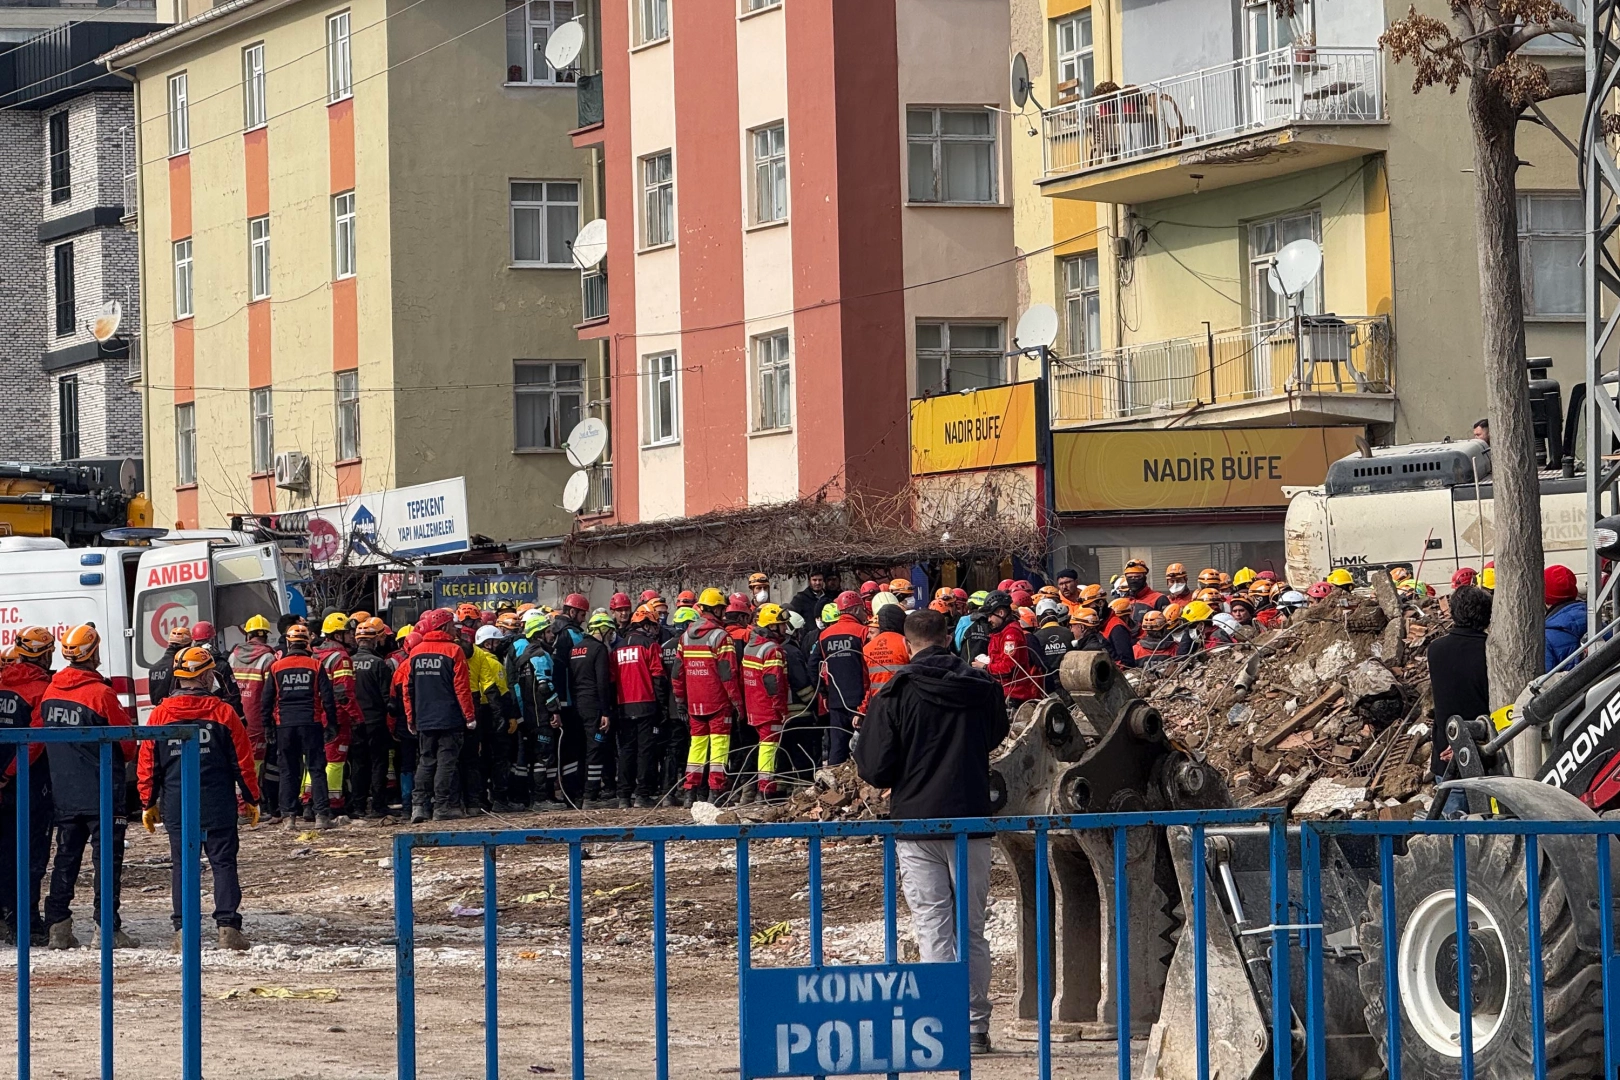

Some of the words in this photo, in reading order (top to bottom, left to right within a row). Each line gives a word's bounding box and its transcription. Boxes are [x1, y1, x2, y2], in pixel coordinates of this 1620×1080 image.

[944, 414, 973, 445] NADİR
[975, 411, 1001, 441] BÜFE
[1143, 452, 1215, 482] NADİR
[1221, 450, 1283, 481] BÜFE
[406, 495, 445, 520] TEPEKENT
[397, 528, 412, 542] YAPI
[413, 515, 455, 540] MALZEMELERİ
[1333, 555, 1369, 565] HMK
[147, 561, 208, 587] AMBU
[442, 580, 534, 598] KEÇELİKOYAK
[0, 607, 23, 624] T.C.
[827, 639, 851, 651] AFAD
[1045, 642, 1066, 650] ANDA
[353, 660, 371, 670] FAD
[415, 658, 442, 669] AFAD
[282, 674, 310, 685] AFAD
[46, 707, 80, 725] AFAD
[798, 970, 920, 1004] KONYA
[776, 1006, 944, 1073] POLİS
